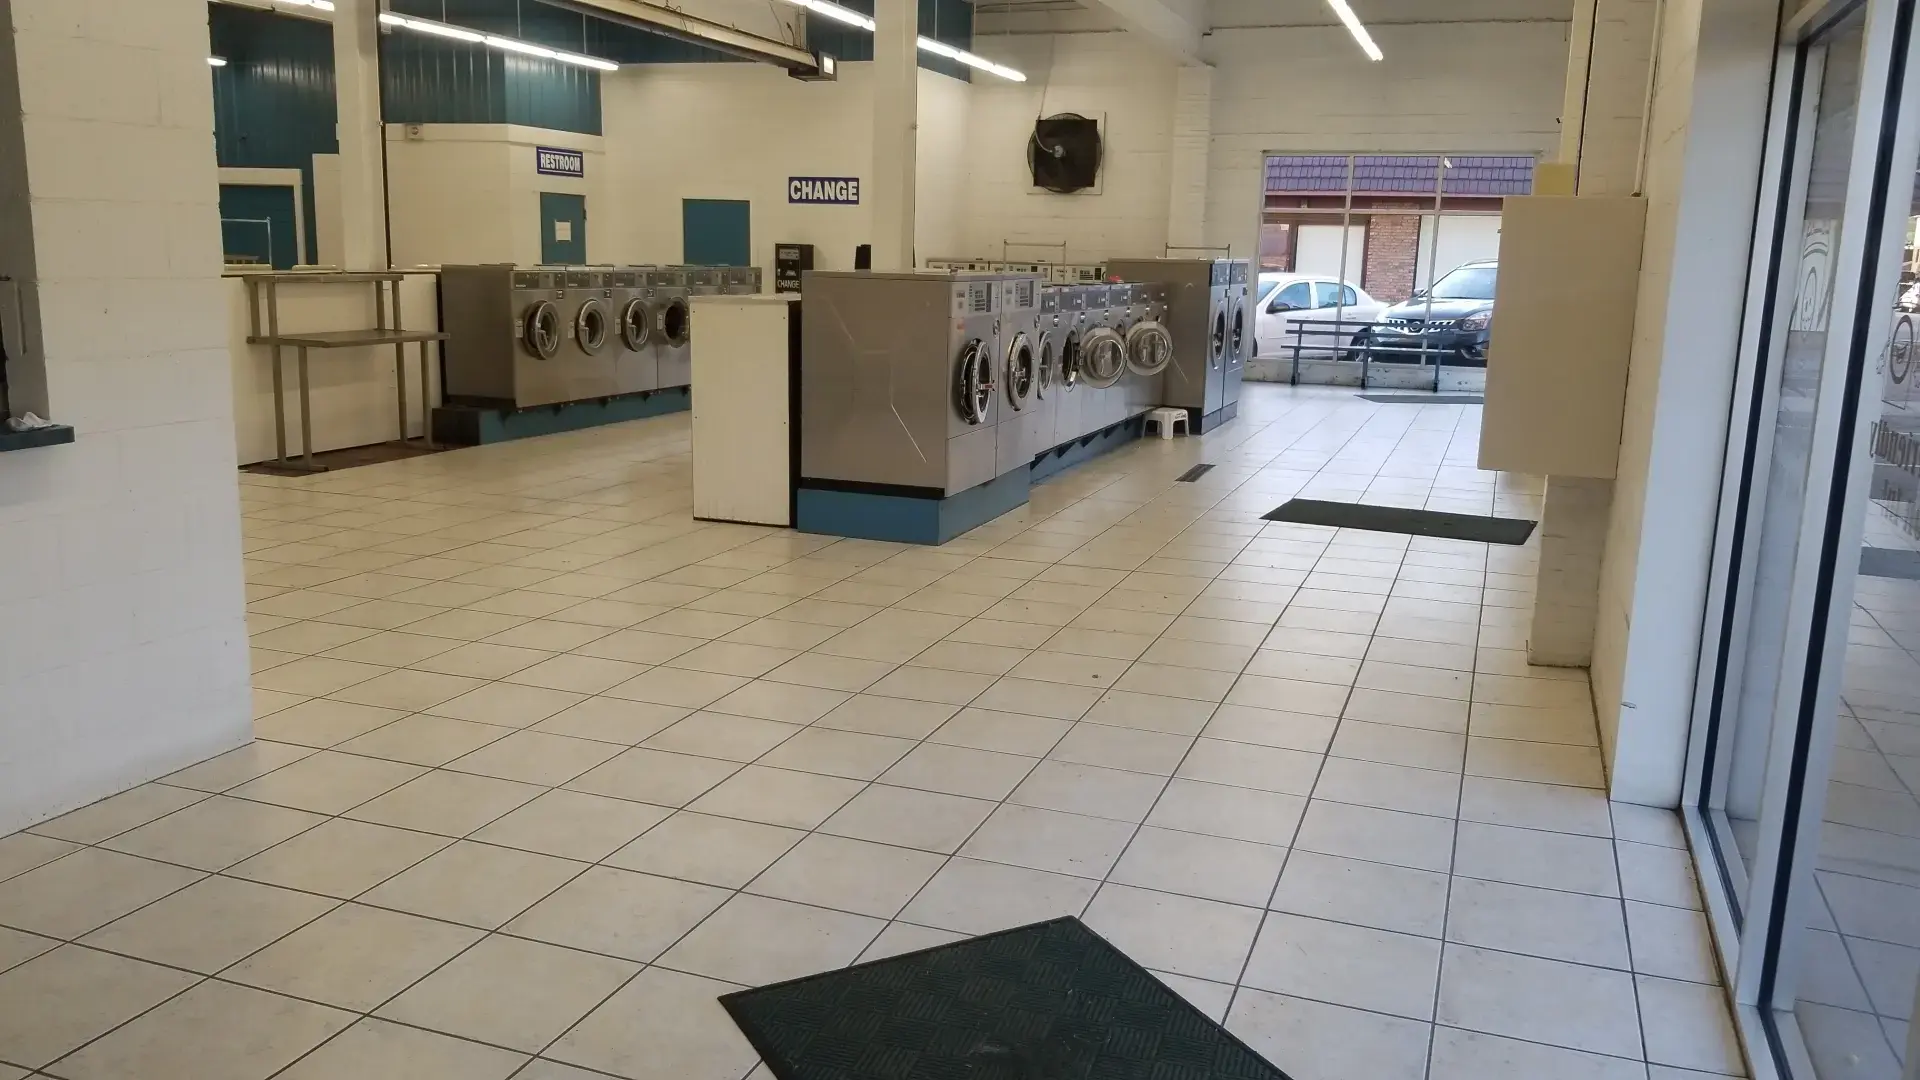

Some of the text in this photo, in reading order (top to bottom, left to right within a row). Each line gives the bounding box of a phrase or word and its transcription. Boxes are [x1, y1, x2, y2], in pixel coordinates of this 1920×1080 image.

[541, 153, 580, 171] RESTROOM
[790, 180, 858, 200] CHANGE
[777, 279, 800, 289] CHANGE
